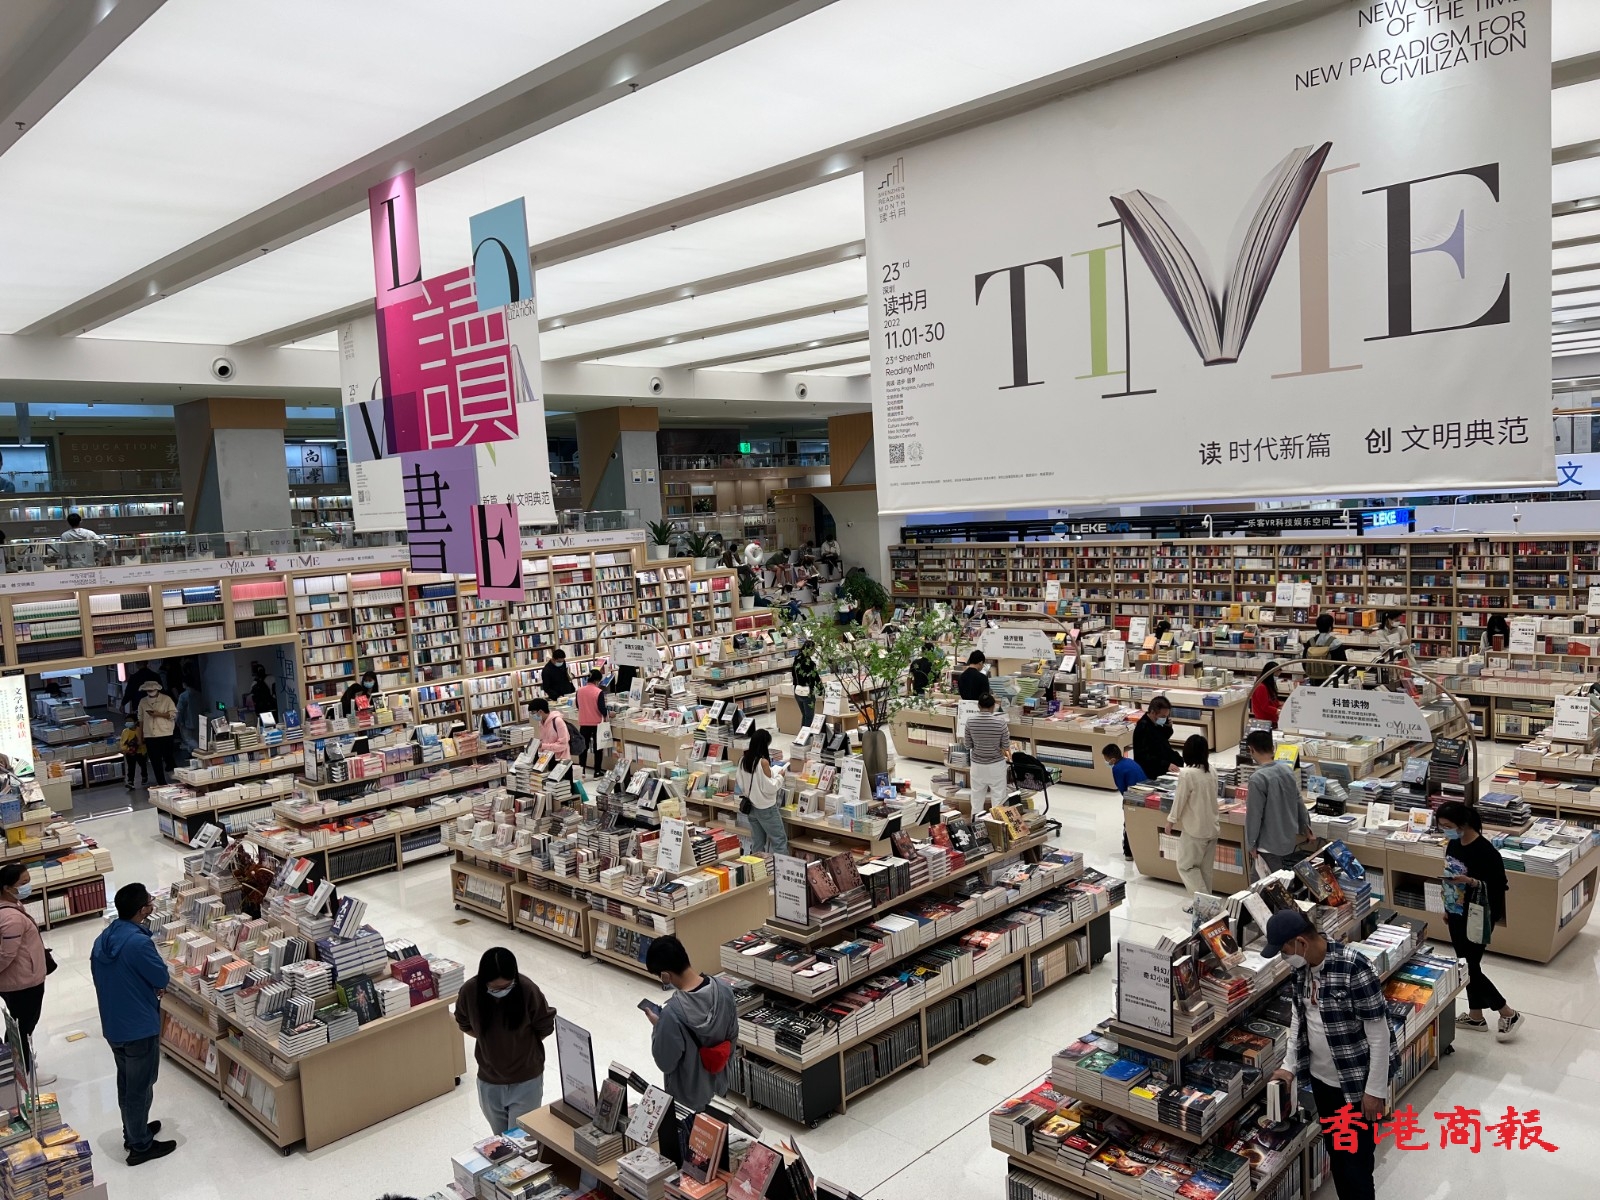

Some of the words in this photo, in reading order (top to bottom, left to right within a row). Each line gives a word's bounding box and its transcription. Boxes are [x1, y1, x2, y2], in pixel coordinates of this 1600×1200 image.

[1386, 12, 1417, 37] OF
[1424, 0, 1465, 26] THE
[1294, 62, 1344, 91] NEW
[1349, 25, 1471, 77] PARADIGM
[1478, 10, 1526, 40] FOR
[1380, 29, 1527, 85] CIVILIZATION
[878, 193, 905, 205] READING
[878, 200, 906, 213] MONTH
[879, 207, 906, 224] 读书月
[883, 289, 927, 317] 读书月
[883, 318, 901, 329] 2022
[884, 321, 945, 349] 11.01-30
[898, 351, 931, 363] Shenzhen
[885, 366, 913, 377] Reading
[913, 361, 935, 373] Month
[71, 443, 158, 451] EDUCATION
[1198, 440, 1223, 467] 读
[1227, 431, 1332, 464] 时代新篇
[1363, 427, 1392, 455] 创
[1400, 415, 1529, 453] 文明典范
[73, 455, 125, 463] BOOKS
[1557, 460, 1583, 487] 文
[1247, 517, 1332, 528] 乐客VR科技娱乐空间
[286, 554, 321, 569] TIME
[1332, 697, 1370, 710] 科普读物
[1143, 971, 1170, 985] 奇幻小说
[1153, 965, 1170, 977] 科幻/
